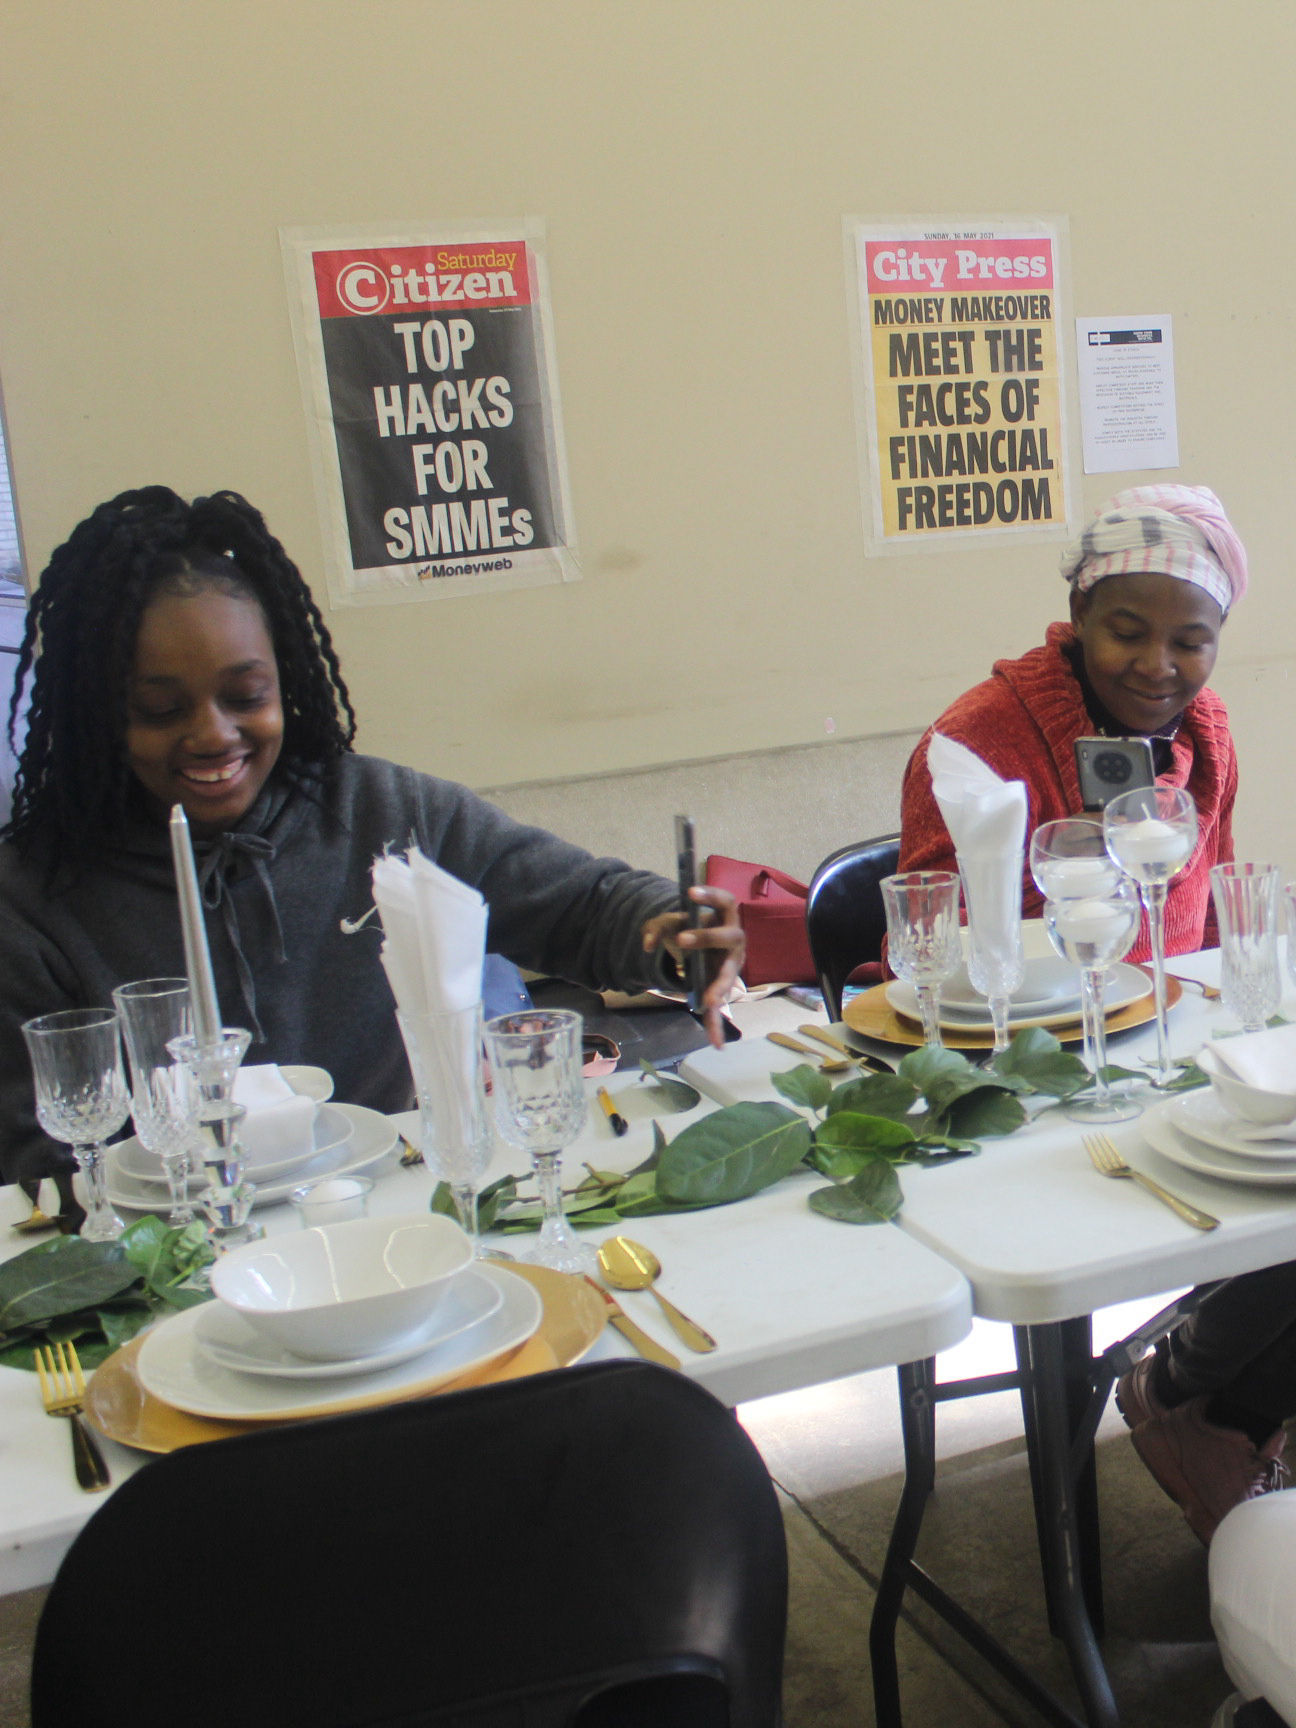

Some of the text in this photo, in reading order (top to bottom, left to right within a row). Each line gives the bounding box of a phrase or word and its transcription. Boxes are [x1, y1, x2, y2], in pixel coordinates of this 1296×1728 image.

[437, 250, 517, 270] Saturday
[873, 248, 1047, 288] City Press
[337, 262, 517, 315] Citizen
[874, 295, 1051, 325] MONEY MAKEOVER
[394, 319, 475, 373] TOP
[889, 328, 1043, 377] MEET THE
[373, 376, 514, 437] HACKS
[897, 378, 1039, 428] FACES OF
[412, 440, 494, 495] FOR
[889, 428, 1053, 480] FINANCIAL
[383, 497, 534, 559] SMMEs
[897, 478, 1052, 530] FREEDOM
[432, 558, 513, 577] Moneyweb
